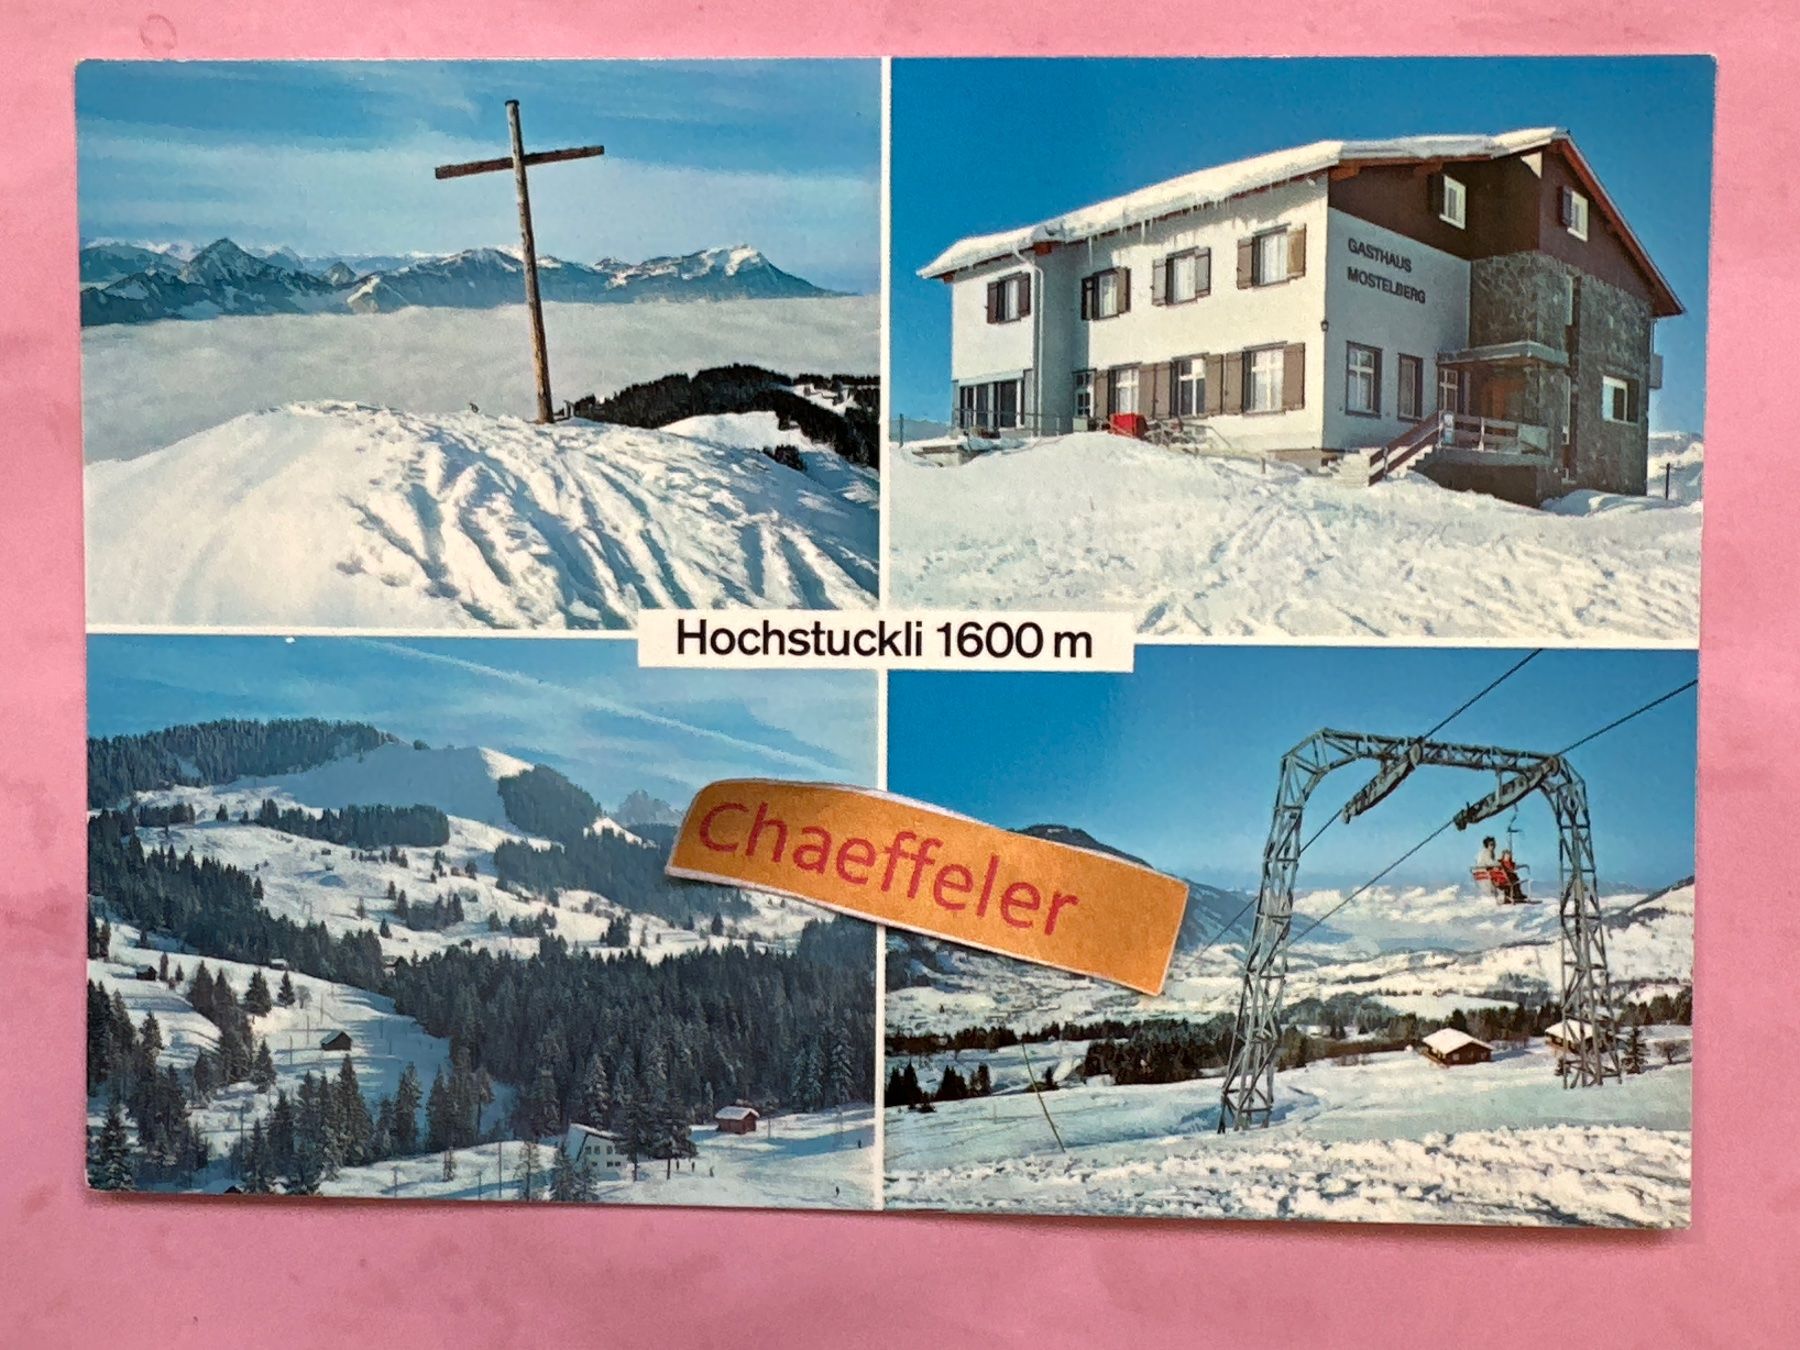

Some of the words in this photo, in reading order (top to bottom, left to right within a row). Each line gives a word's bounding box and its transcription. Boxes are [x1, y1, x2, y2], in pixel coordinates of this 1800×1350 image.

[1347, 237, 1412, 273] GASTHAUS
[1347, 266, 1426, 304] MOSTELBERG
[677, 618, 923, 657] Hochstuckli
[937, 621, 1044, 659] 1600
[1054, 630, 1093, 658] m
[699, 802, 1079, 936] Chaeffeler
